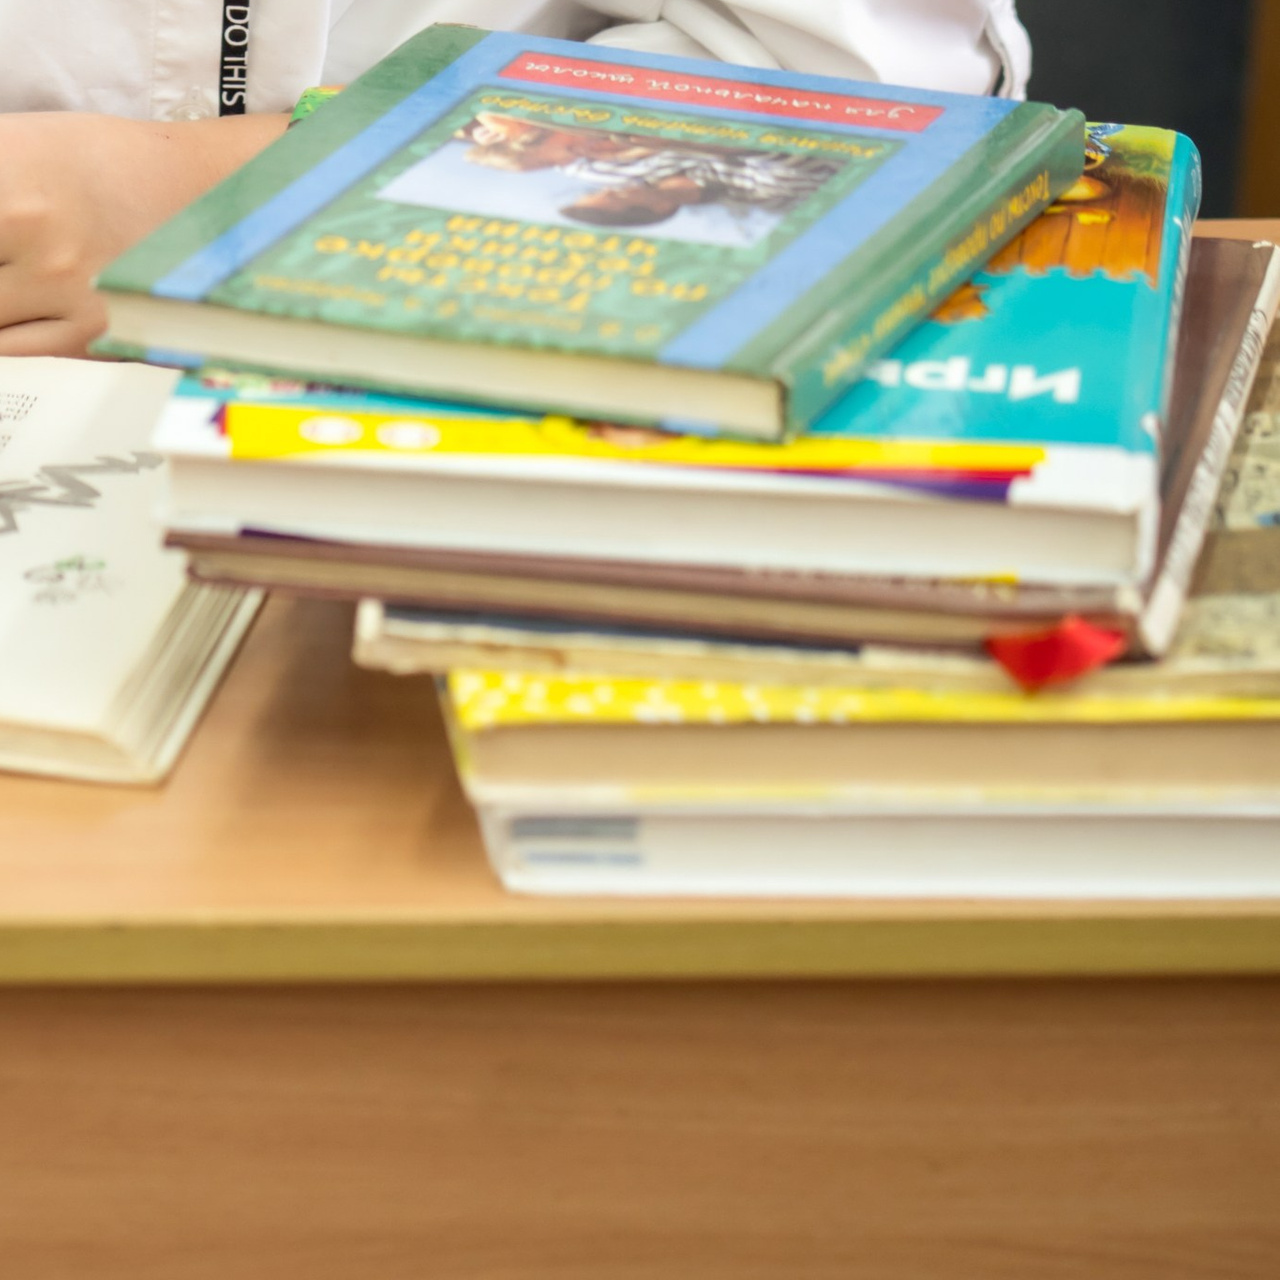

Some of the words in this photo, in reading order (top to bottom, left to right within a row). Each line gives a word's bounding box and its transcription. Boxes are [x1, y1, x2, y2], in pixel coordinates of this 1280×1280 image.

[224, 4, 250, 47] DO
[222, 54, 247, 107] THIS
[524, 59, 636, 86] школы
[645, 77, 833, 113] начальной
